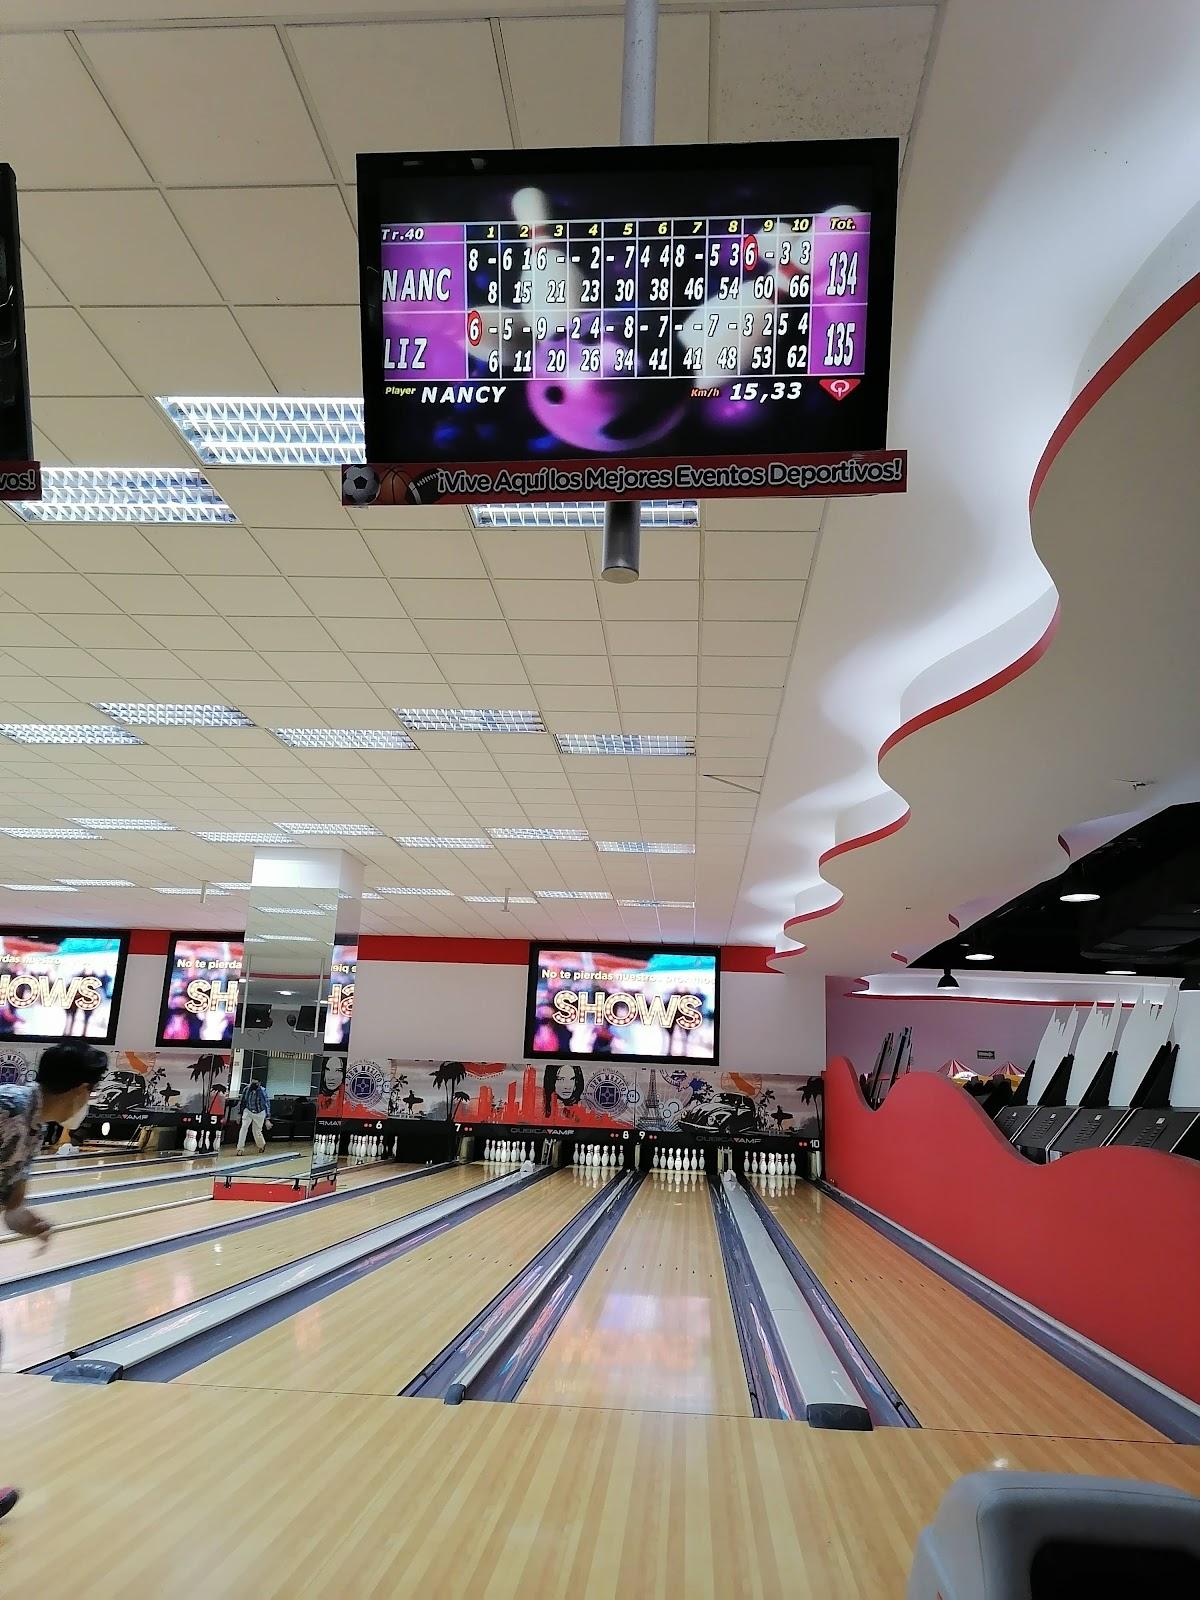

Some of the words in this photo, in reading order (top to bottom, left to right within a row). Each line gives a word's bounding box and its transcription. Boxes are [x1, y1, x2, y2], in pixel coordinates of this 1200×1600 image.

[381, 228, 425, 241] Tr.40
[486, 226, 495, 238] 1
[519, 225, 529, 238] 2
[553, 224, 564, 237] 3
[588, 223, 598, 236] 4
[622, 223, 633, 235] 5
[657, 222, 668, 234] 6
[692, 222, 702, 234] 7
[728, 220, 738, 232] 8
[763, 219, 773, 232] 9
[791, 218, 810, 231] 10
[830, 217, 856, 230] Tot.
[468, 248, 479, 271] 8
[502, 248, 513, 271] 6
[521, 248, 532, 270] 1
[537, 247, 547, 270] 6
[590, 246, 600, 269] 2
[624, 245, 635, 268] 7
[640, 245, 650, 268] 4
[659, 244, 670, 267] 4
[674, 244, 685, 267] 8
[709, 243, 720, 266] 5
[729, 242, 739, 266] 3
[745, 242, 755, 266] 6
[780, 241, 791, 265] 3
[800, 241, 811, 264] 3
[382, 268, 452, 301] NANC
[826, 252, 858, 296] 134
[487, 281, 498, 304] 8
[512, 281, 532, 304] 15
[546, 280, 566, 303] 21
[580, 279, 600, 303] 23
[614, 278, 634, 302] 30
[649, 278, 669, 301] 38
[684, 277, 703, 300] 46
[718, 276, 739, 300] 54
[753, 275, 774, 299] 60
[789, 275, 810, 298] 66
[469, 318, 479, 341] 6
[503, 318, 513, 341] 5
[537, 317, 547, 340] 9
[571, 316, 581, 339] 2
[590, 316, 600, 338] 4
[623, 315, 634, 338] 8
[658, 315, 669, 338] 7
[708, 314, 719, 337] 7
[743, 313, 754, 336] 3
[762, 312, 773, 336] 2
[777, 312, 789, 335] 5
[798, 312, 808, 334] 4
[383, 338, 428, 369] LIZ
[824, 322, 856, 366] 135
[488, 350, 498, 373] 6
[513, 350, 532, 372] 11
[546, 349, 566, 372] 20
[580, 349, 600, 372] 26
[614, 348, 634, 371] 34
[648, 348, 668, 370] 41
[683, 348, 702, 370] 41
[717, 346, 737, 370] 48
[751, 345, 772, 369] 53
[787, 345, 807, 368] 62
[385, 386, 416, 397] Player
[421, 386, 506, 404] NANCY
[690, 388, 720, 398] Km/h
[730, 382, 802, 404] 15,33
[493, 468, 549, 495] Aquí
[550, 468, 582, 491] los
[585, 466, 672, 493] Mejores
[675, 464, 764, 488] Eventos
[768, 458, 903, 488] Deportivos!
[177, 958, 191, 968] No
[194, 959, 206, 969] te
[541, 969, 556, 979] No
[560, 970, 572, 980] te
[574, 970, 613, 982] pierdas
[552, 990, 702, 1030] SHOWS
[195, 1114, 202, 1124] 4
[210, 1115, 218, 1125] 5
[375, 1120, 383, 1129] 6
[454, 1123, 462, 1132] 7
[622, 1131, 629, 1140] 8
[638, 1131, 646, 1140] 9
[809, 1139, 820, 1148] 10
